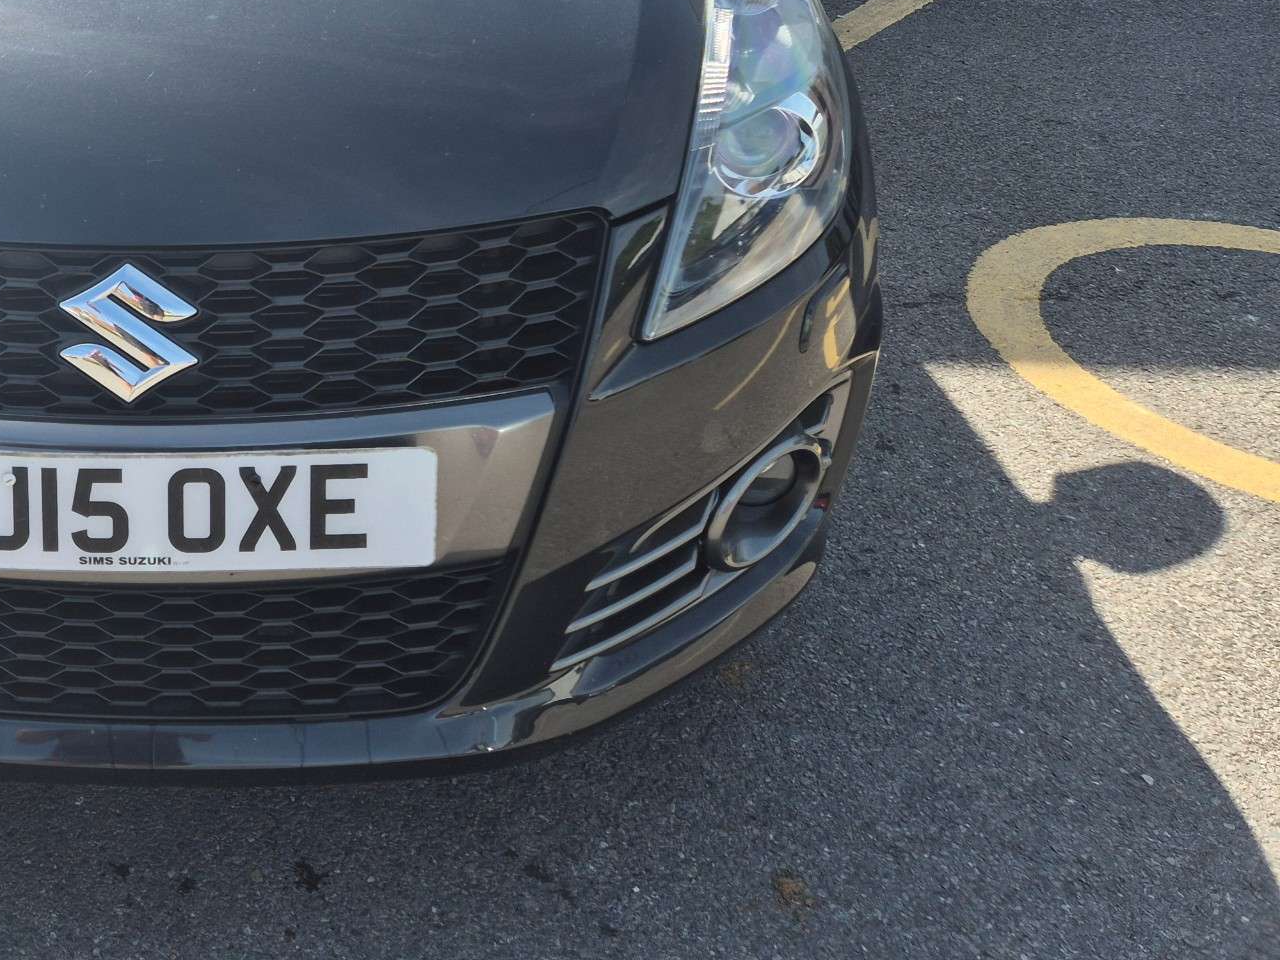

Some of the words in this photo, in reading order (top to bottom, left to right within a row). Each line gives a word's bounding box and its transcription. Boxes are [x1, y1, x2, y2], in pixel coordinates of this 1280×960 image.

[167, 463, 369, 553] OXE
[79, 556, 114, 566] SIMS
[118, 556, 172, 566] SUZUKI
